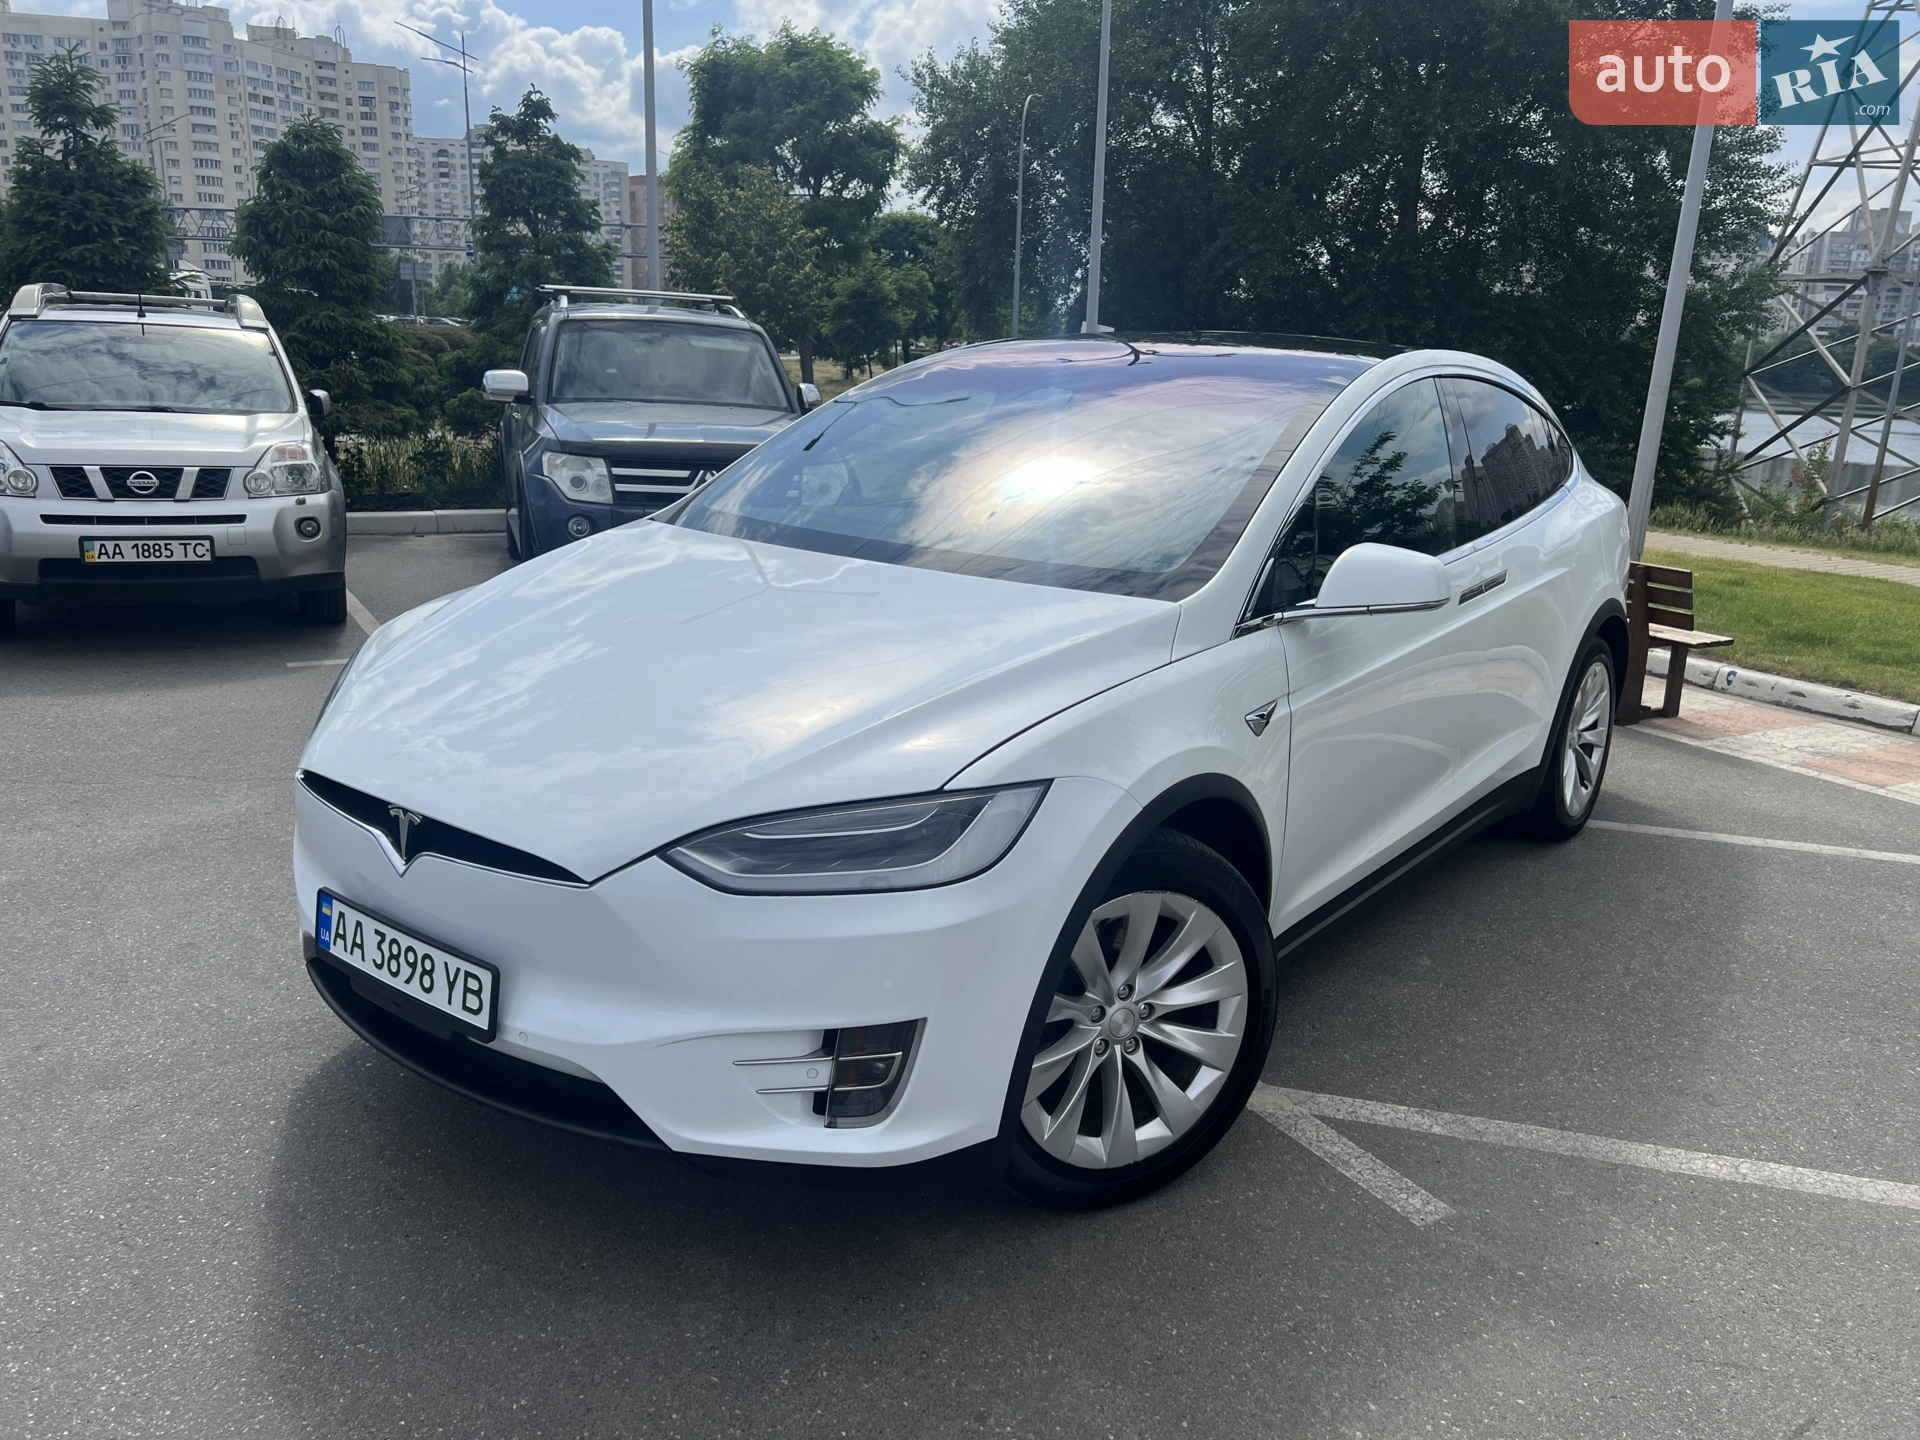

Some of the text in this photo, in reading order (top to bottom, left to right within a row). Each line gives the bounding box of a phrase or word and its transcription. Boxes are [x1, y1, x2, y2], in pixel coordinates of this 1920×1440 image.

[97, 542, 206, 560] AA 1885 TC
[320, 927, 330, 942] UA
[333, 910, 484, 1016] AA 3898 YB
